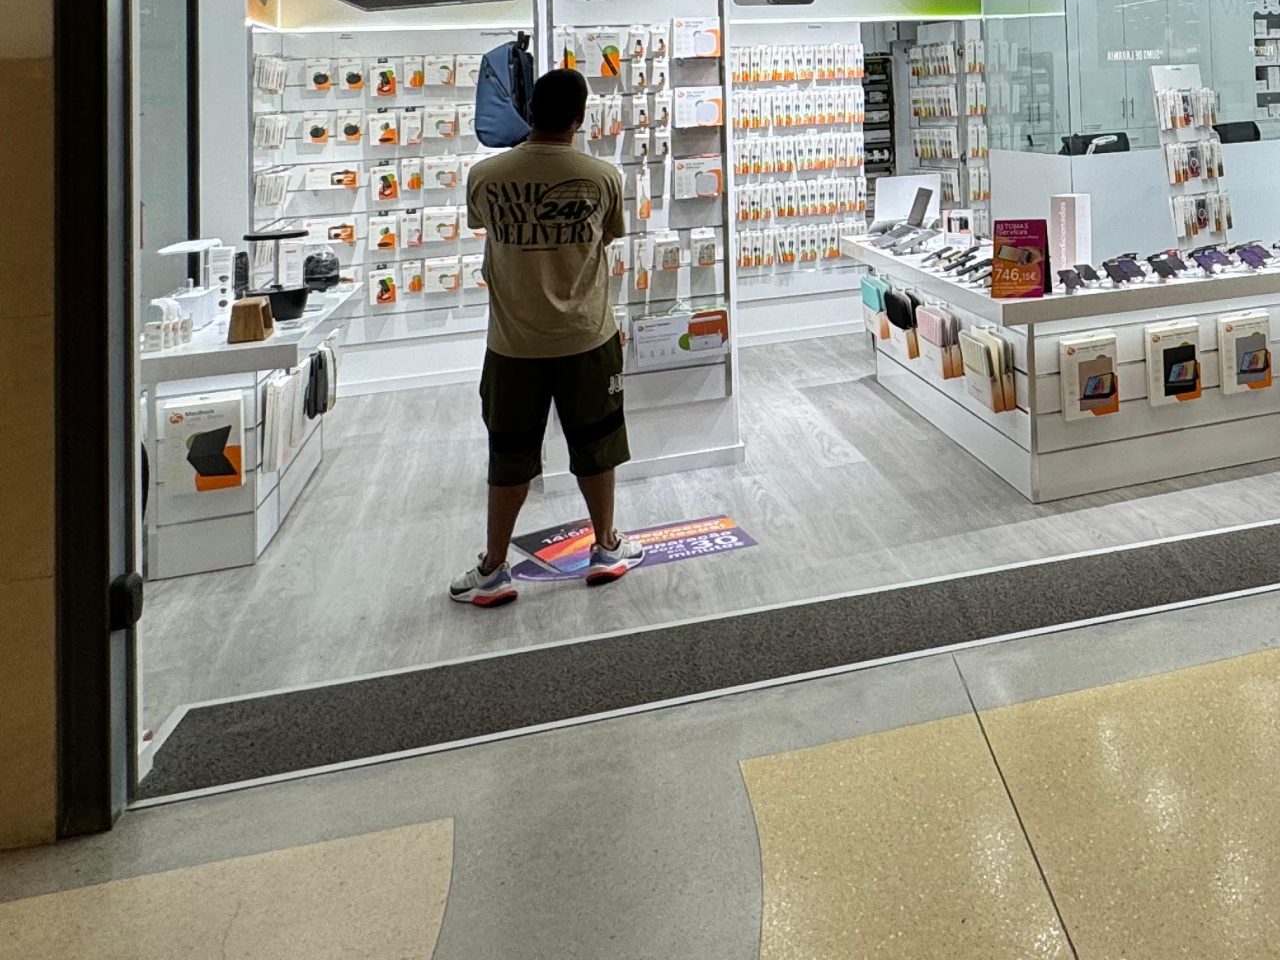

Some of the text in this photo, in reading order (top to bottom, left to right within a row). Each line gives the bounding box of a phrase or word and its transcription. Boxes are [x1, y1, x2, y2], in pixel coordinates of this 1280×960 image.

[486, 181, 550, 204] SAME
[489, 202, 529, 224] DAY
[490, 223, 595, 245] DELIVERY
